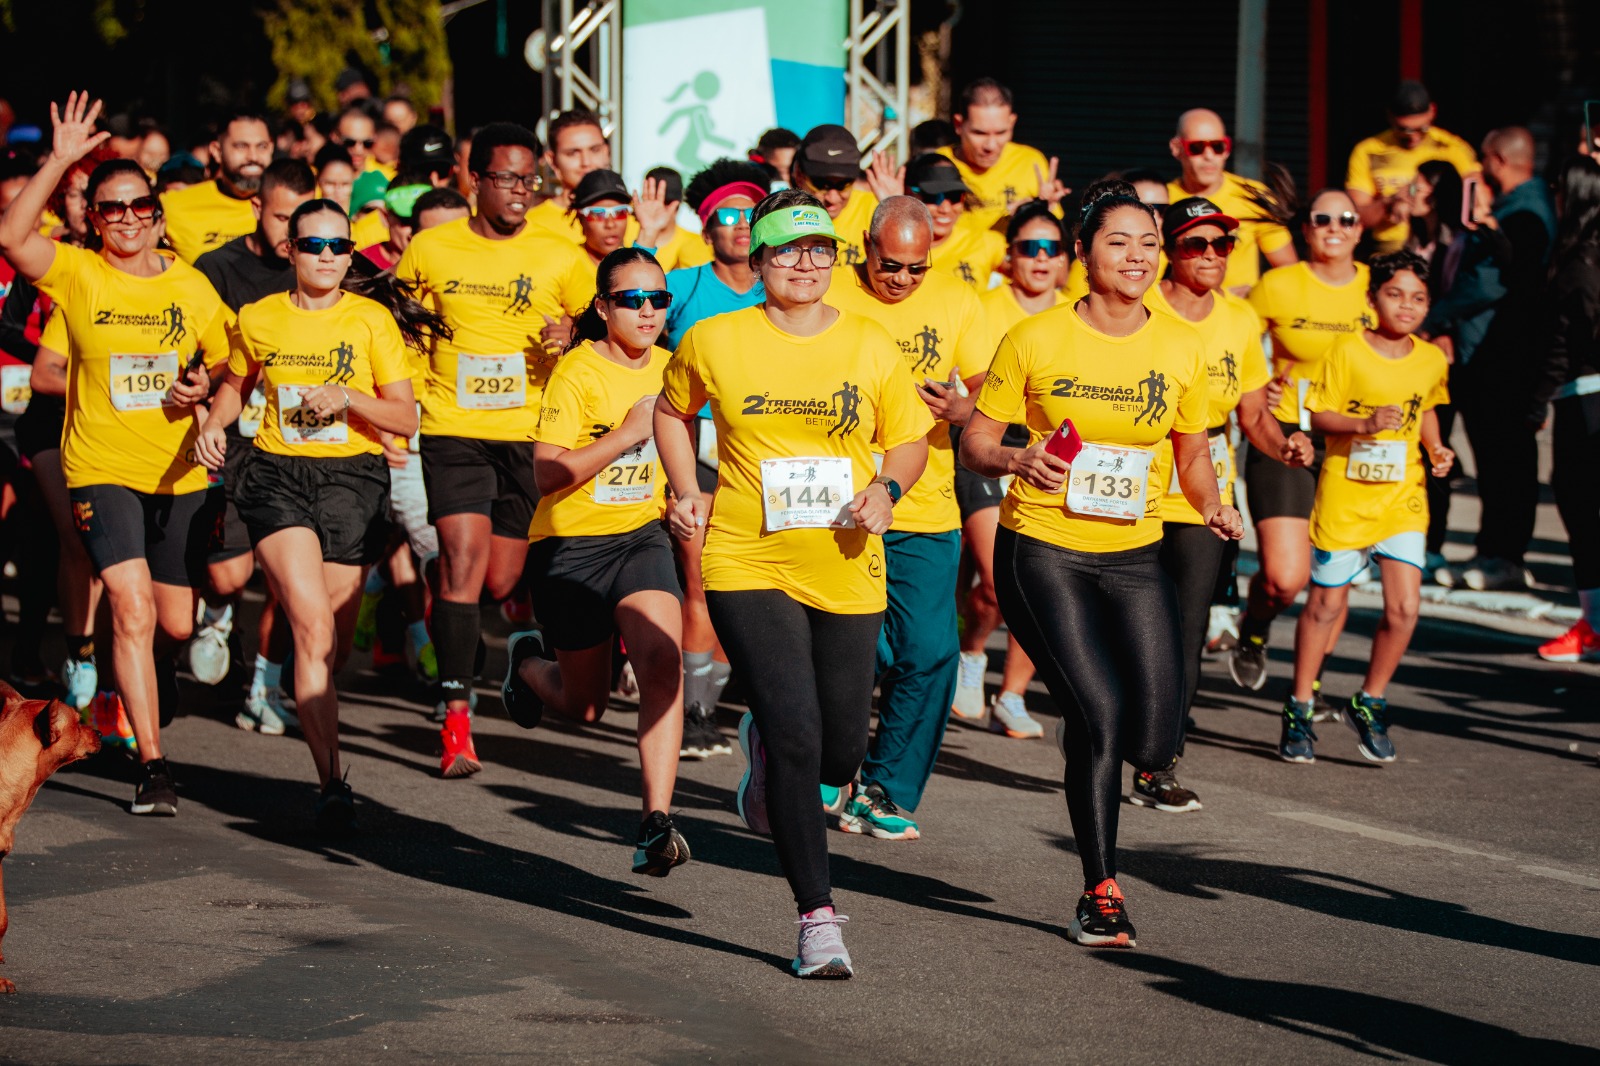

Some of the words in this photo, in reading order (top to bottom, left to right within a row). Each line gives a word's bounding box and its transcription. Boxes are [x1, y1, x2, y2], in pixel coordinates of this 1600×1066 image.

[141, 327, 167, 335] BETIM
[277, 353, 325, 361] TREINÃO
[305, 368, 332, 376] BETIM
[123, 373, 166, 393] 196
[474, 377, 514, 394] 292
[1074, 384, 1135, 395] TREINÃO
[1072, 391, 1145, 403] LAGOINHA
[765, 398, 828, 409] TREINÃO
[1112, 403, 1144, 413] BETIM
[765, 407, 838, 417] LAGOINHA
[805, 417, 836, 427] BETIM
[608, 464, 650, 486] 274
[1358, 463, 1395, 481] 057
[1084, 473, 1133, 499] 133
[780, 486, 833, 508] 144
